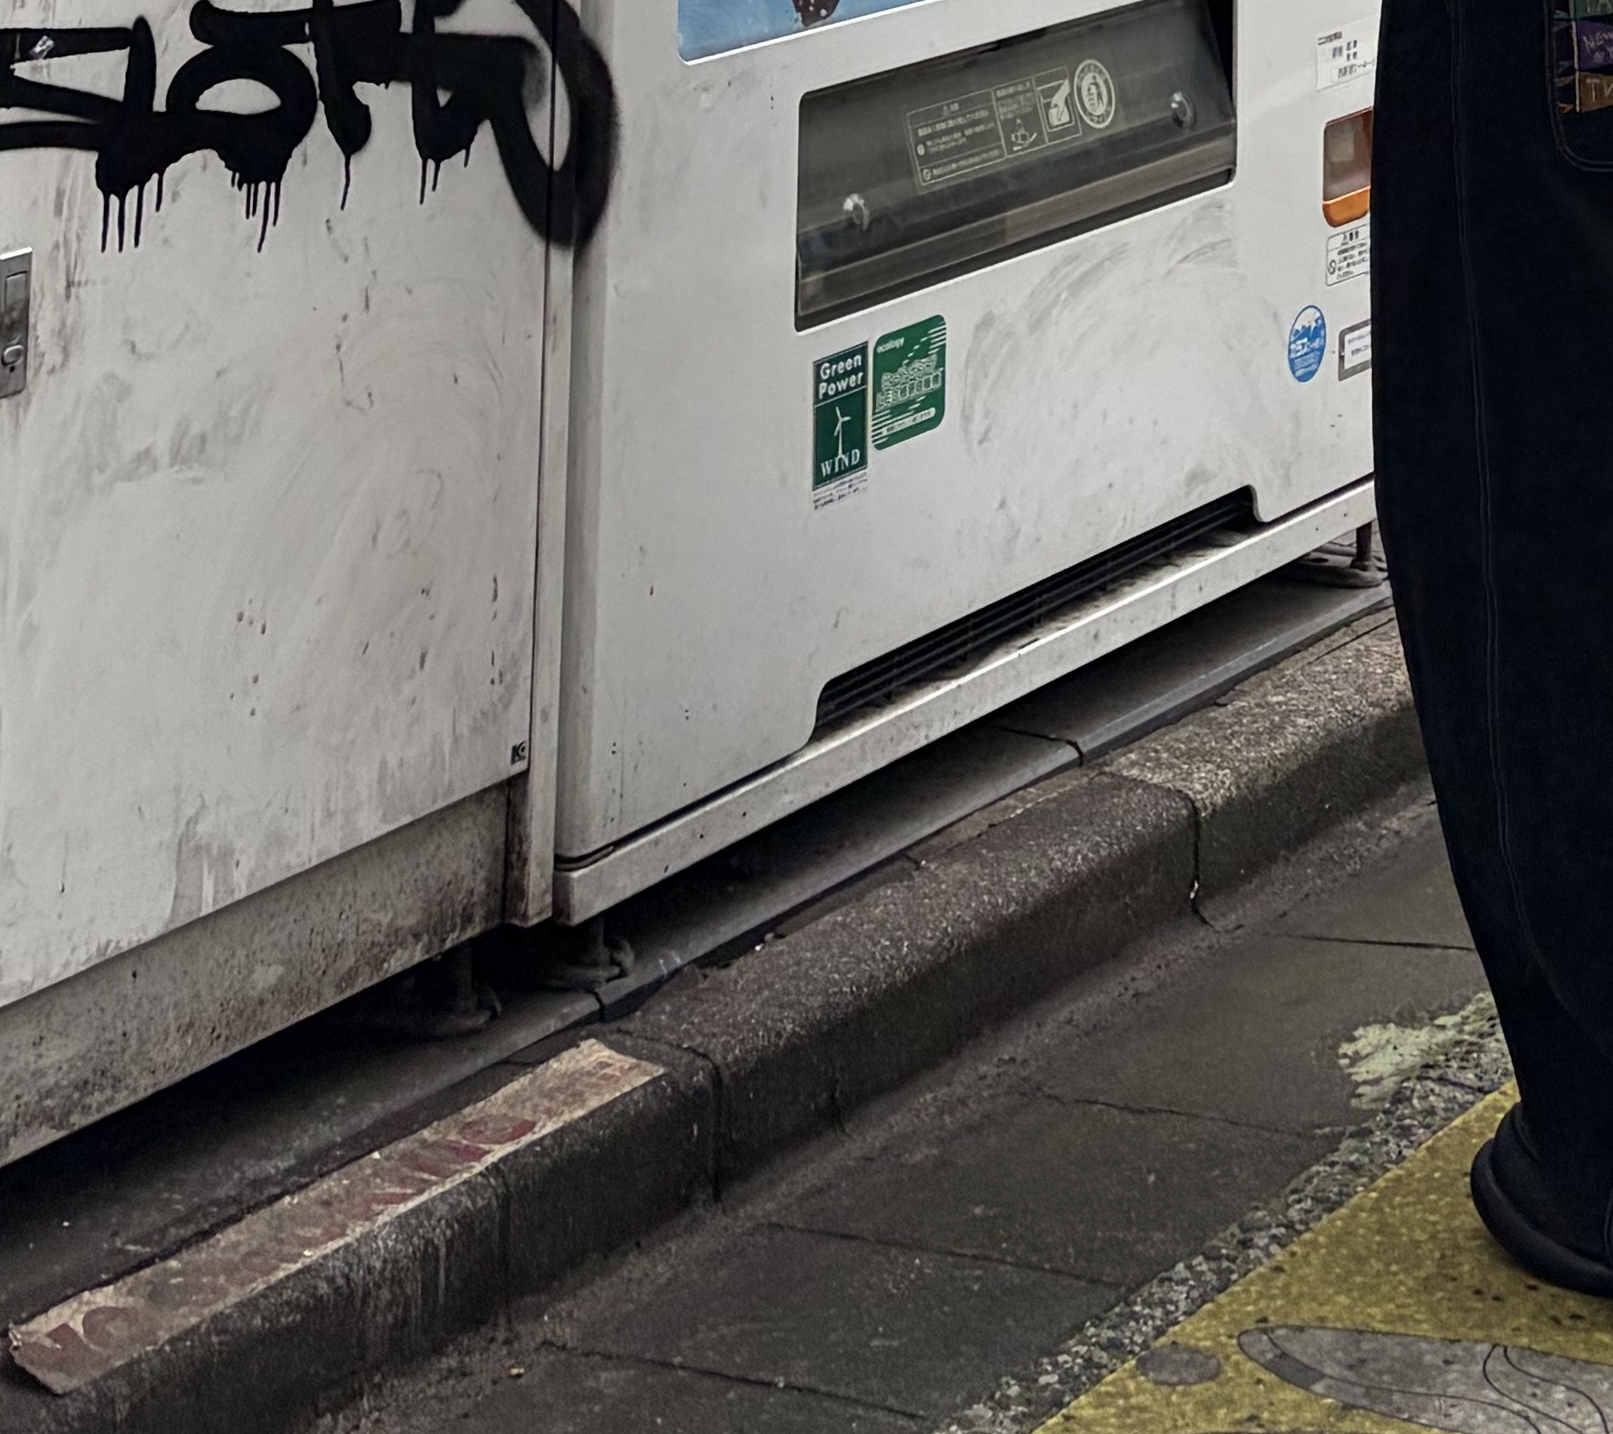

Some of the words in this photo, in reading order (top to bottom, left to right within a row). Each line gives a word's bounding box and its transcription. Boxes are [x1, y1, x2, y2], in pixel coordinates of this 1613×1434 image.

[819, 354, 862, 381] Green
[818, 371, 865, 400] Power
[820, 448, 861, 478] WIND
